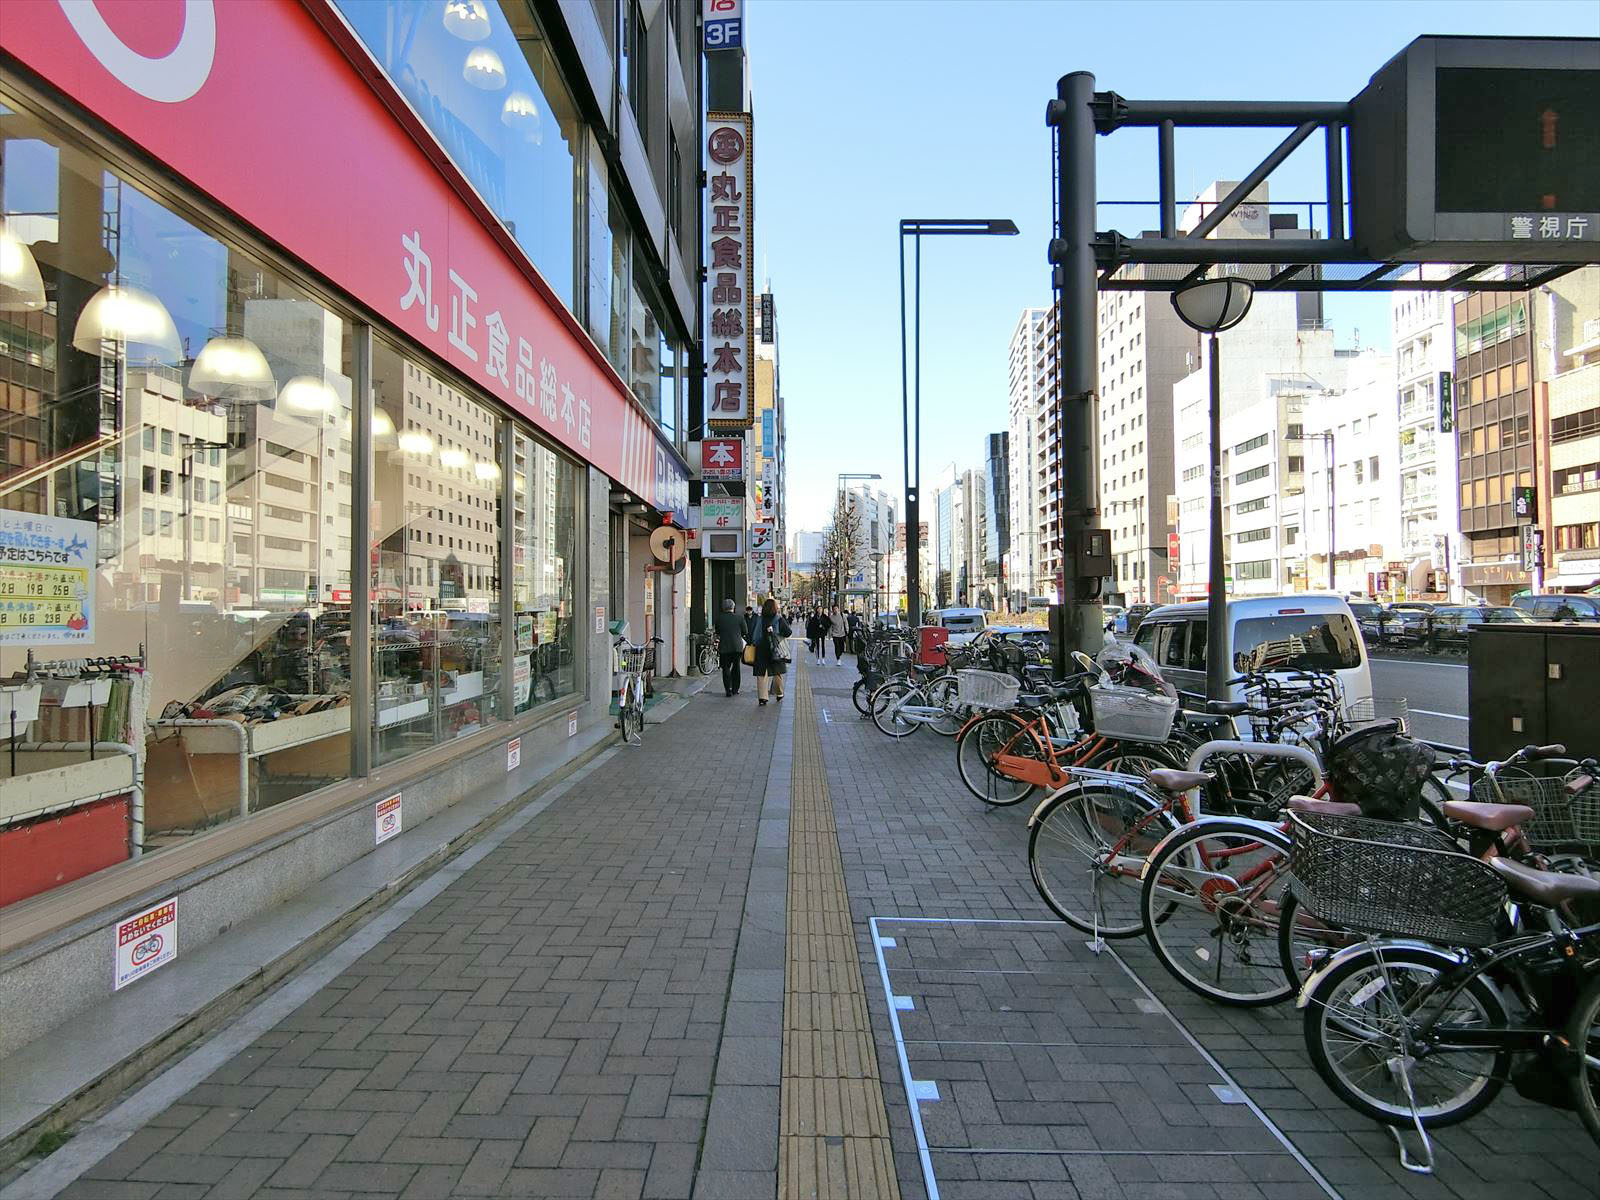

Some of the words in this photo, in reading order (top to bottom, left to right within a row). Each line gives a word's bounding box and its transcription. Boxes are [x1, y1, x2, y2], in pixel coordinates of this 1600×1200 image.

[706, 22, 741, 46] 3F
[1510, 216, 1588, 239] 警視庁
[711, 170, 744, 413] 丸正食品総本店
[400, 230, 592, 450] 丸正食品総本店
[709, 441, 735, 467] 本
[716, 516, 729, 527] 4F
[27, 584, 44, 595] 19日
[53, 585, 70, 596] 25日
[19, 613, 35, 624] 16日
[45, 613, 61, 624] 23日
